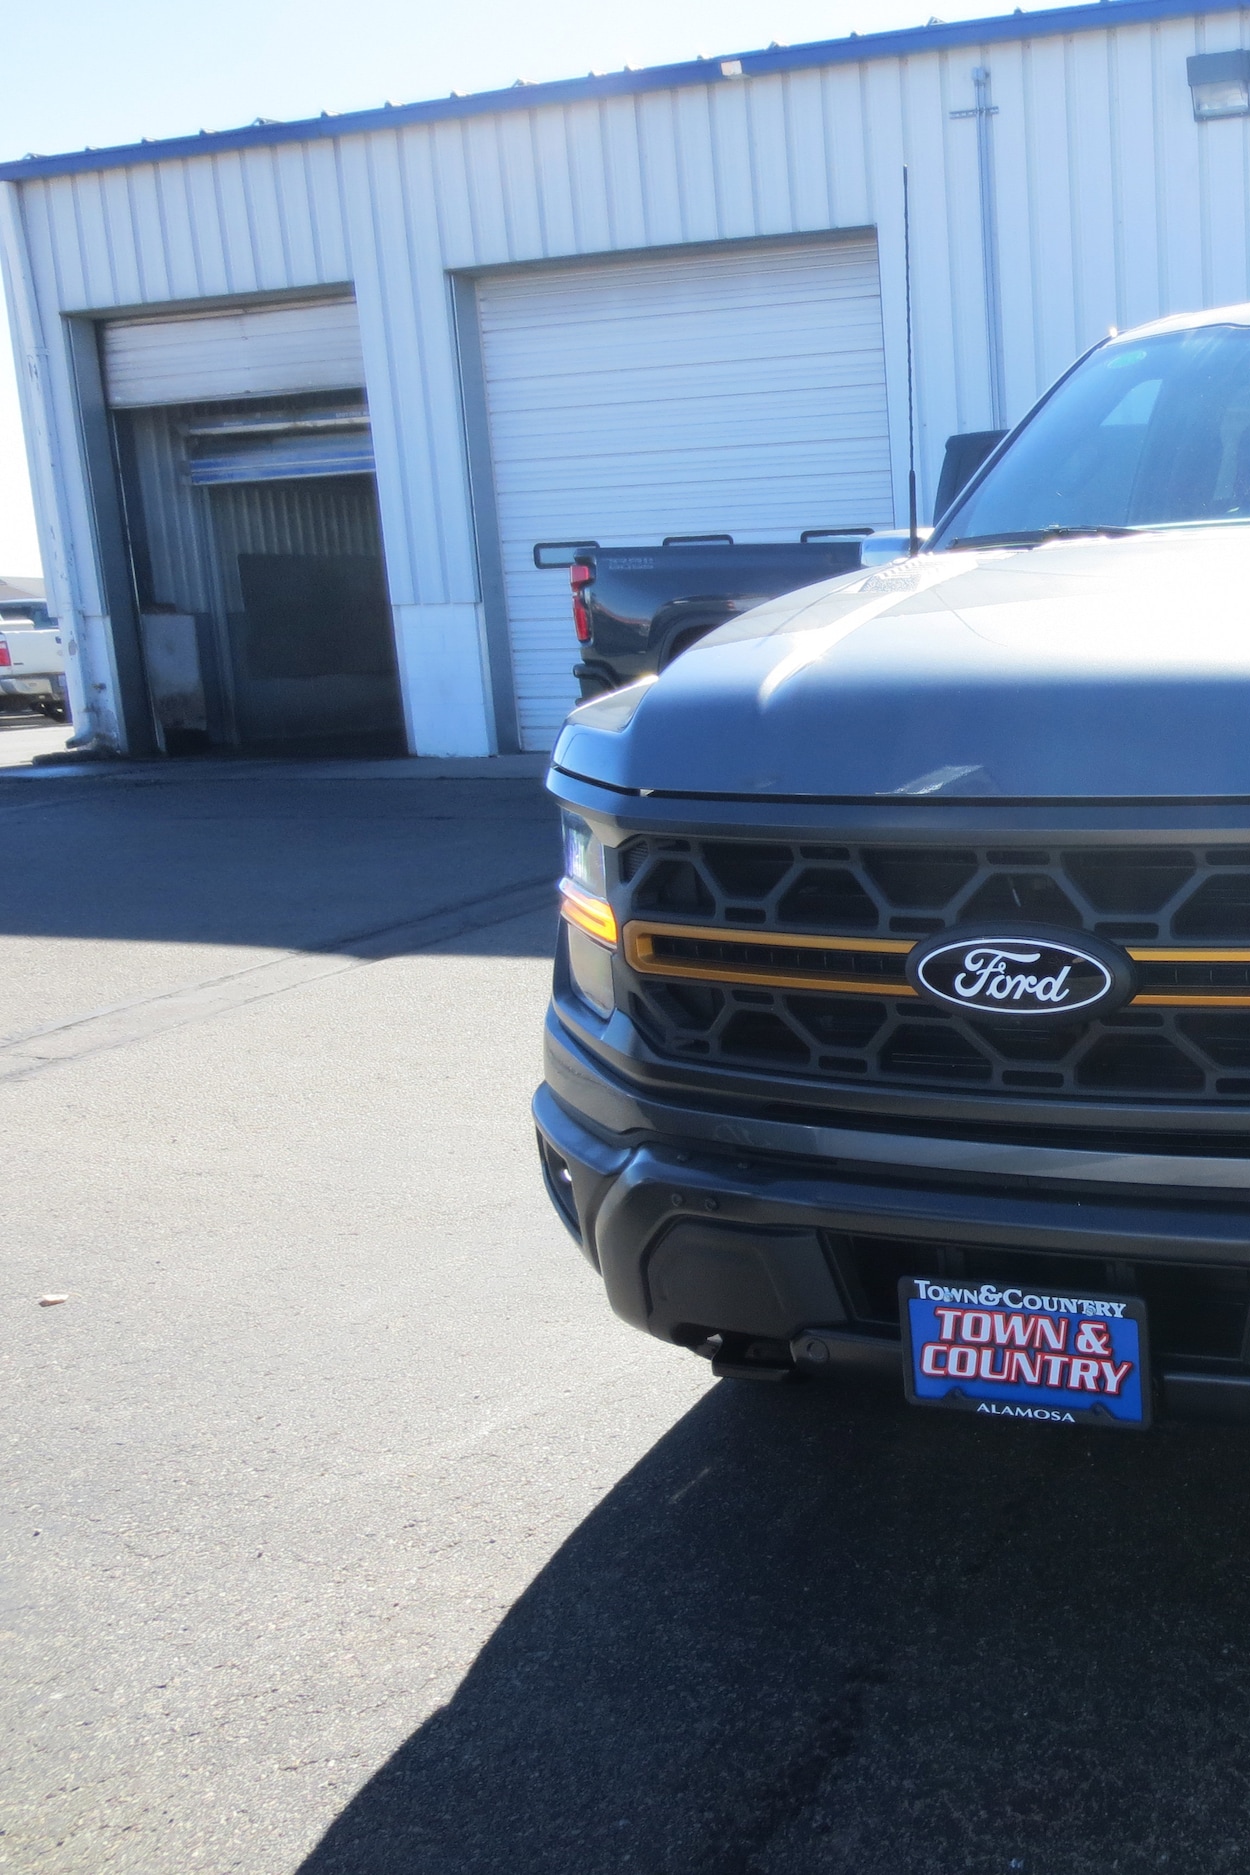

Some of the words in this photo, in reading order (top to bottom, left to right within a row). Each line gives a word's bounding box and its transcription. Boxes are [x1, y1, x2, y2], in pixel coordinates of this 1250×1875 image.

[954, 948, 1072, 1003] Ford
[934, 1307, 1069, 1352] TOWN
[1075, 1320, 1113, 1357] &
[921, 1342, 1133, 1394] COUNTRY
[976, 1402, 1076, 1423] ALAMOSA
